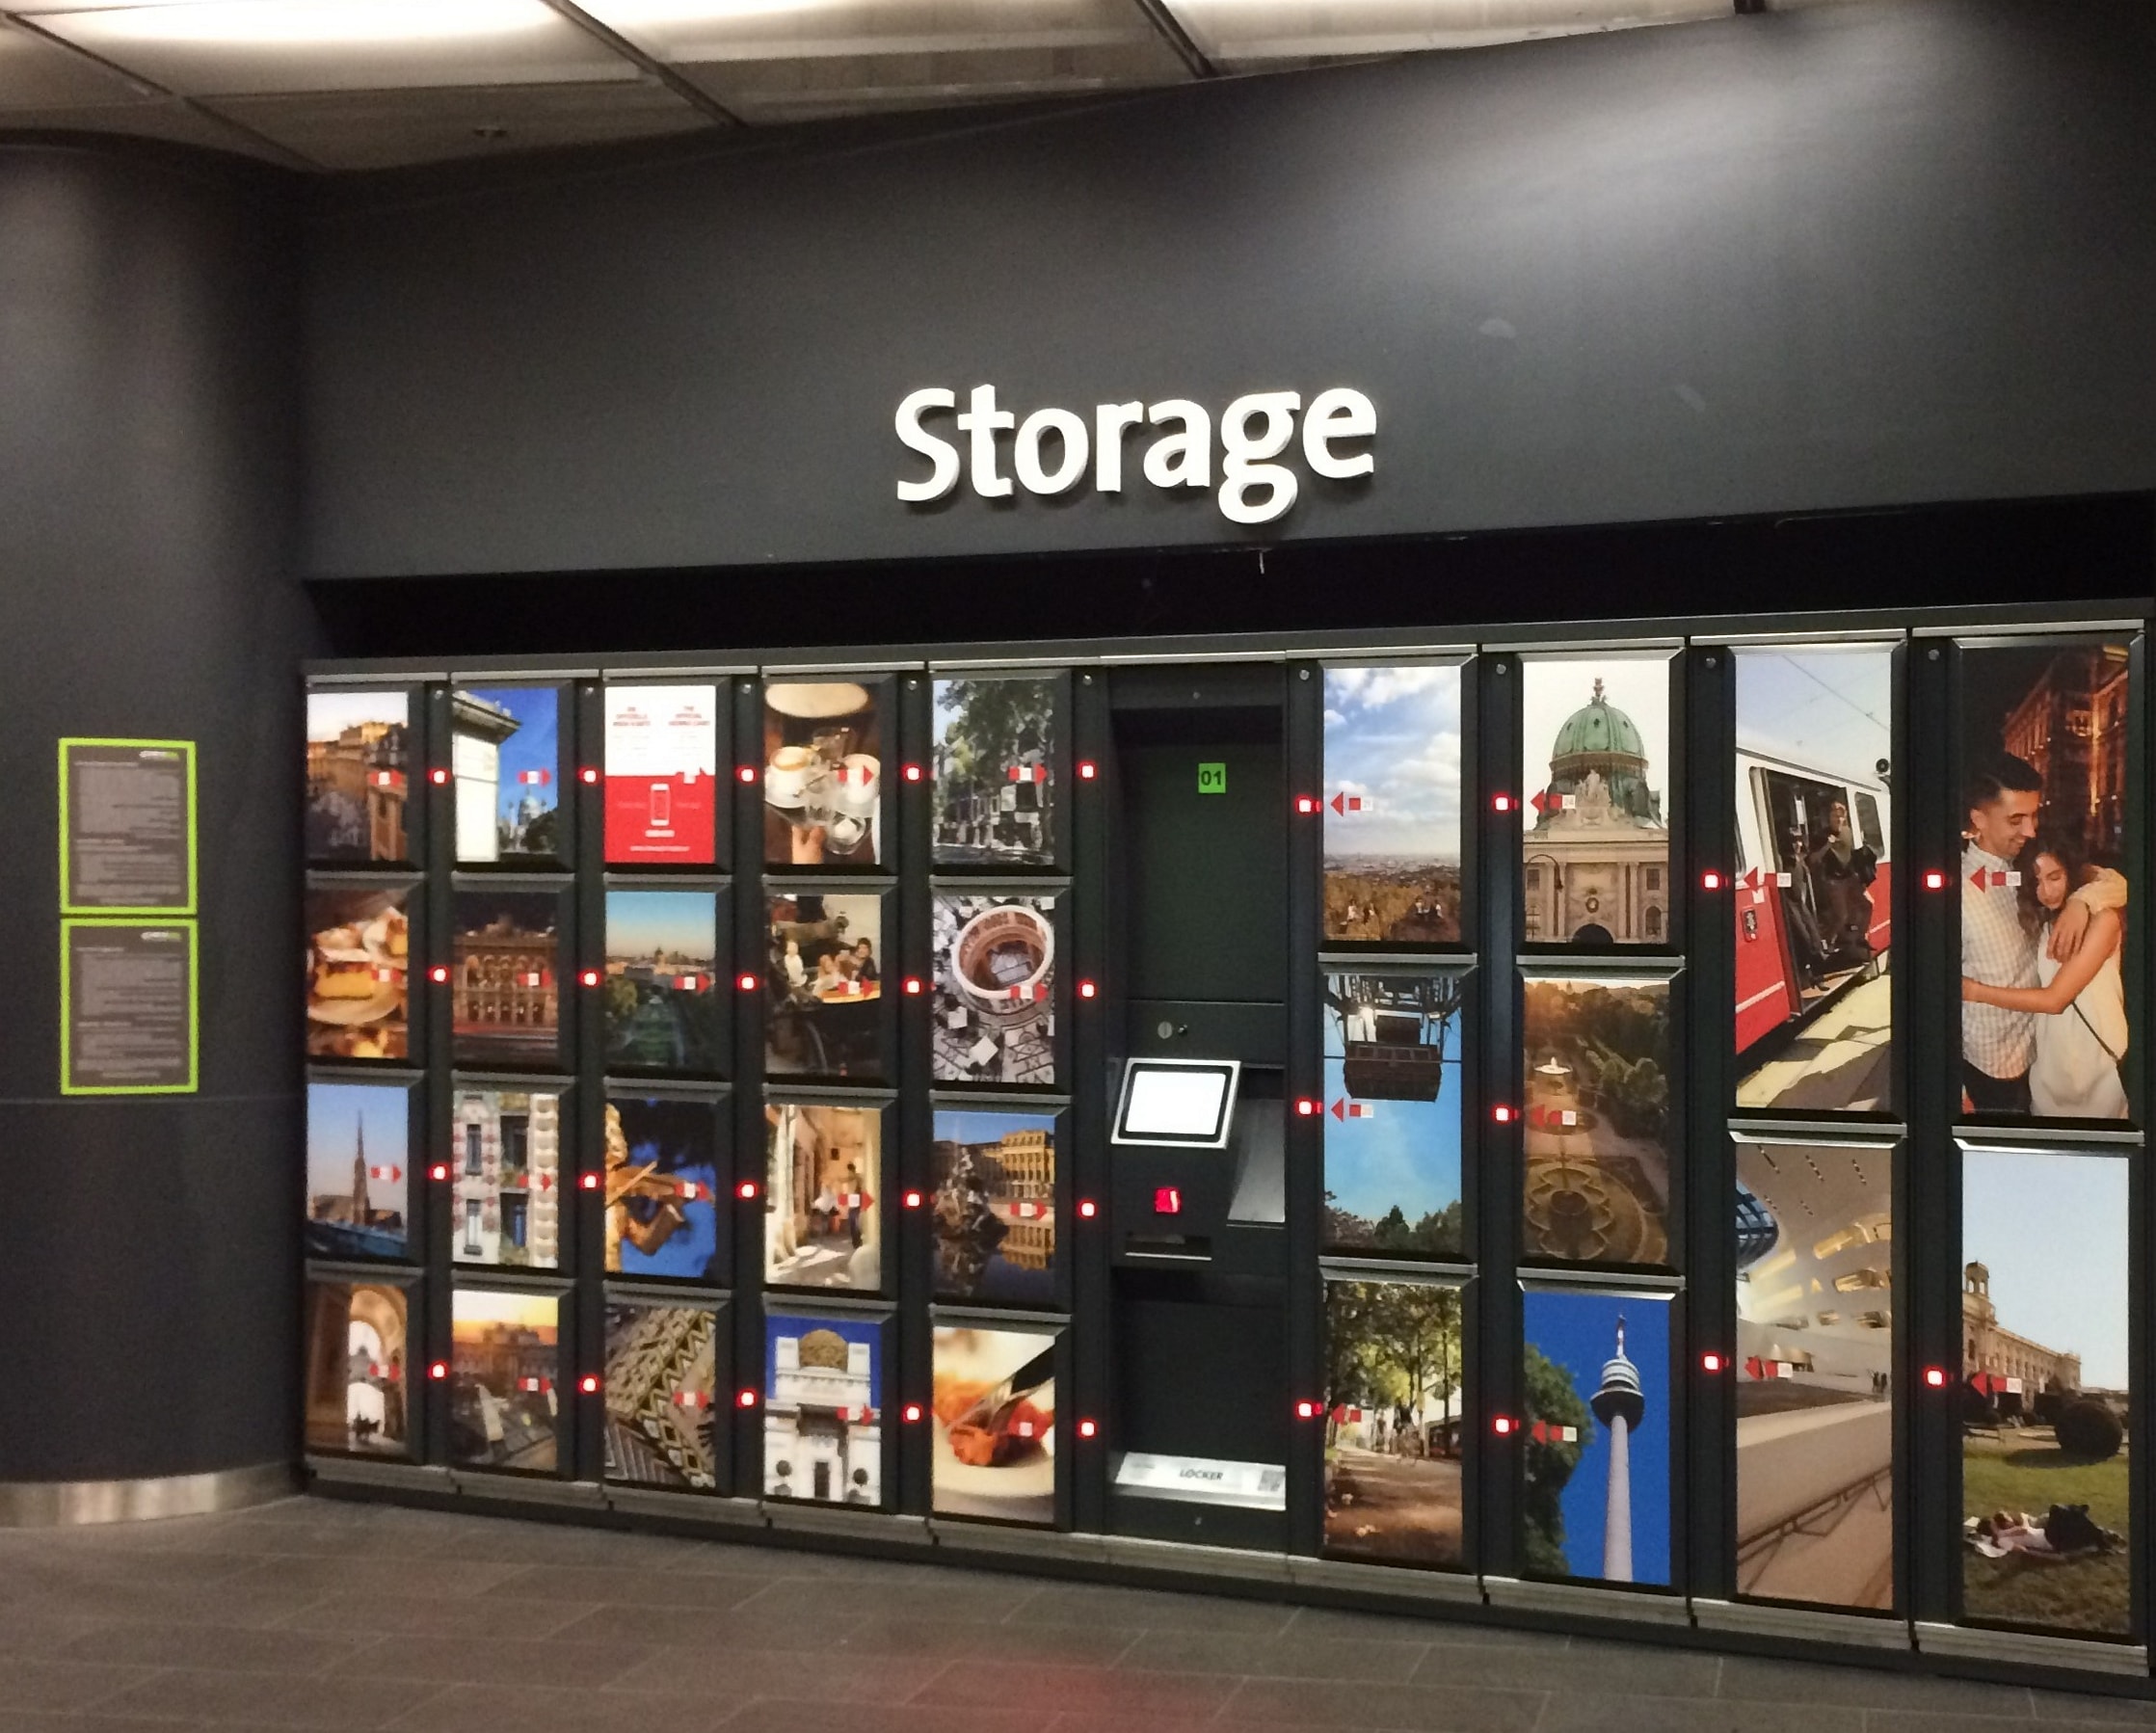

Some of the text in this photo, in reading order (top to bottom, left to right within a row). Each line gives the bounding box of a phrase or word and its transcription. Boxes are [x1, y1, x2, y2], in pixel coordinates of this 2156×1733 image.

[894, 384, 1377, 523] Storage
[1201, 770, 1221, 786] 01
[1180, 1468, 1224, 1480] LOCKER
